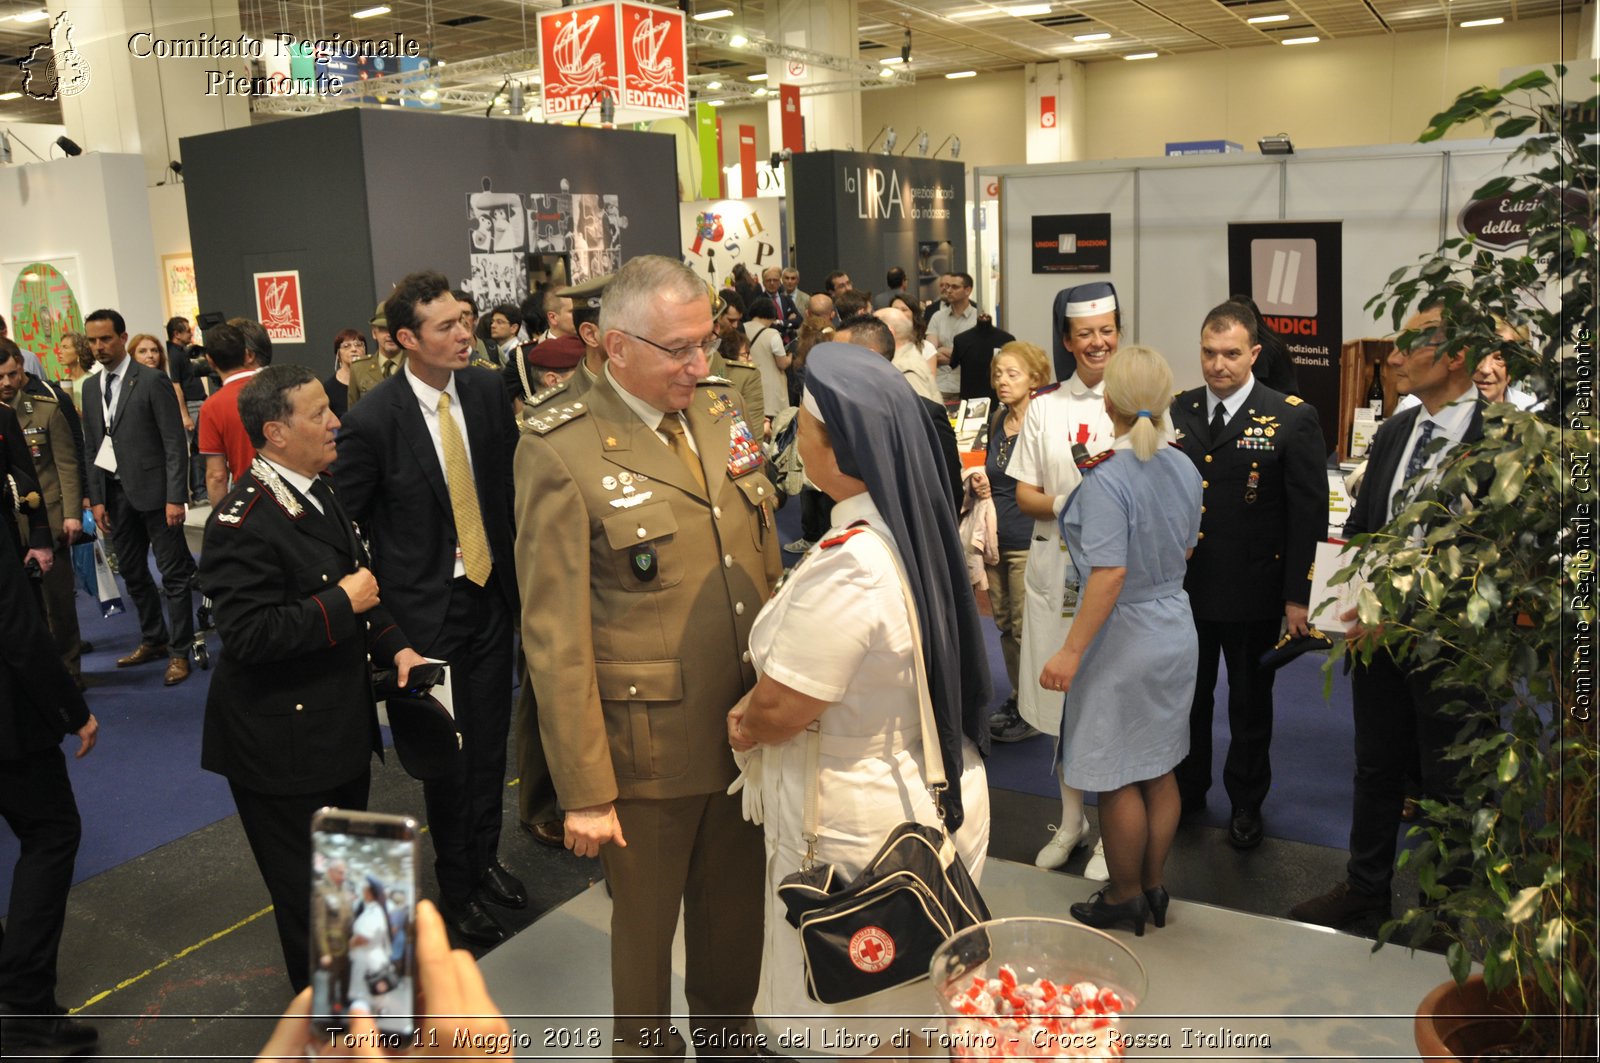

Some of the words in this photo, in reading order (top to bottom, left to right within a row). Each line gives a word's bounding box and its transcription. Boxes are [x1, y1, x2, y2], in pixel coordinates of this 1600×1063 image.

[546, 89, 619, 113] EDITALA
[627, 89, 685, 110] EDITALIA
[844, 166, 855, 193] la
[857, 167, 905, 219] LIRA
[1482, 220, 1521, 234] della
[1077, 240, 1107, 248] EDIZIONI
[268, 327, 302, 338] DITALIA
[1263, 317, 1317, 335] NDICI
[1287, 344, 1328, 354] edizioni.it
[1292, 356, 1329, 366] dizioni.it
